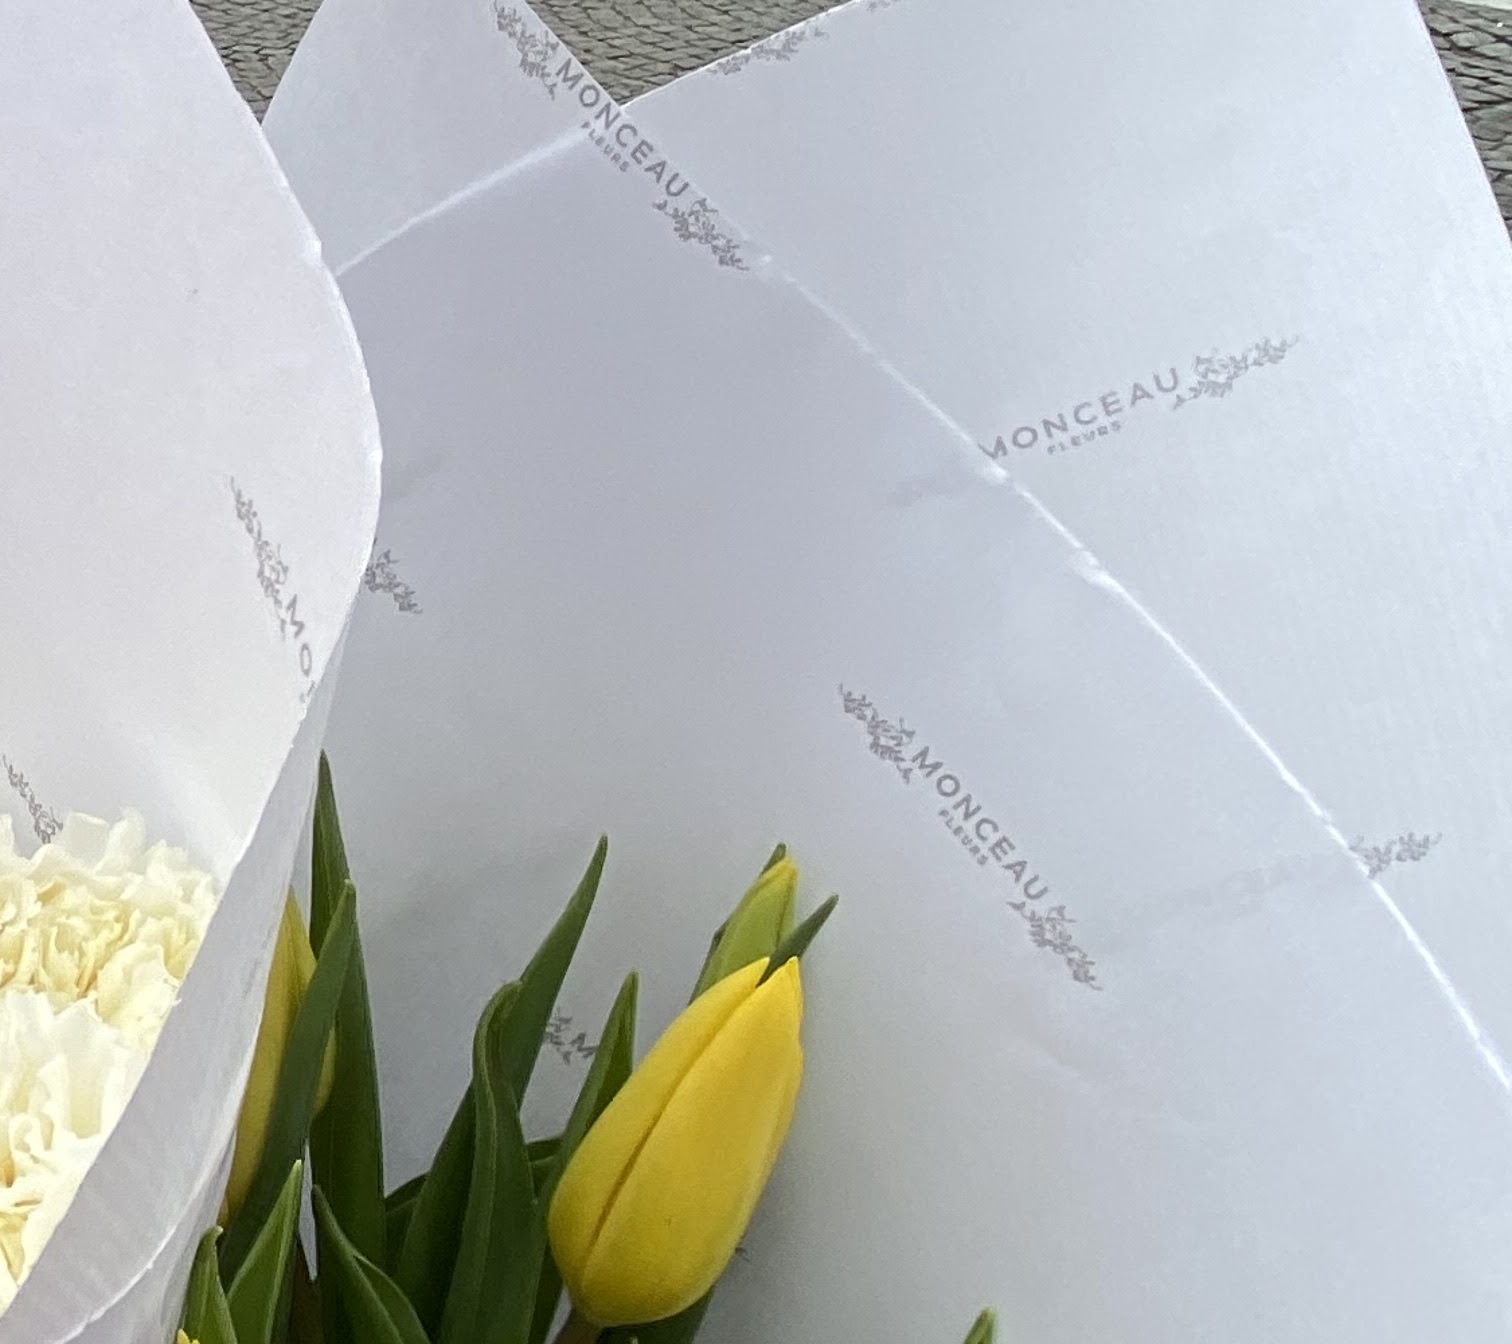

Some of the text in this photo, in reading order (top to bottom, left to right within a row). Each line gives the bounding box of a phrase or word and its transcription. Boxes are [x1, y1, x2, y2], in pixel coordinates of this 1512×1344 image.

[555, 57, 689, 197] MONCEAU
[580, 121, 629, 173] FLEURS
[978, 367, 1179, 460] MONCEAU
[1047, 419, 1122, 455] FLEURS
[911, 746, 1048, 901] MONCEAU
[938, 809, 988, 866] FLEURS
